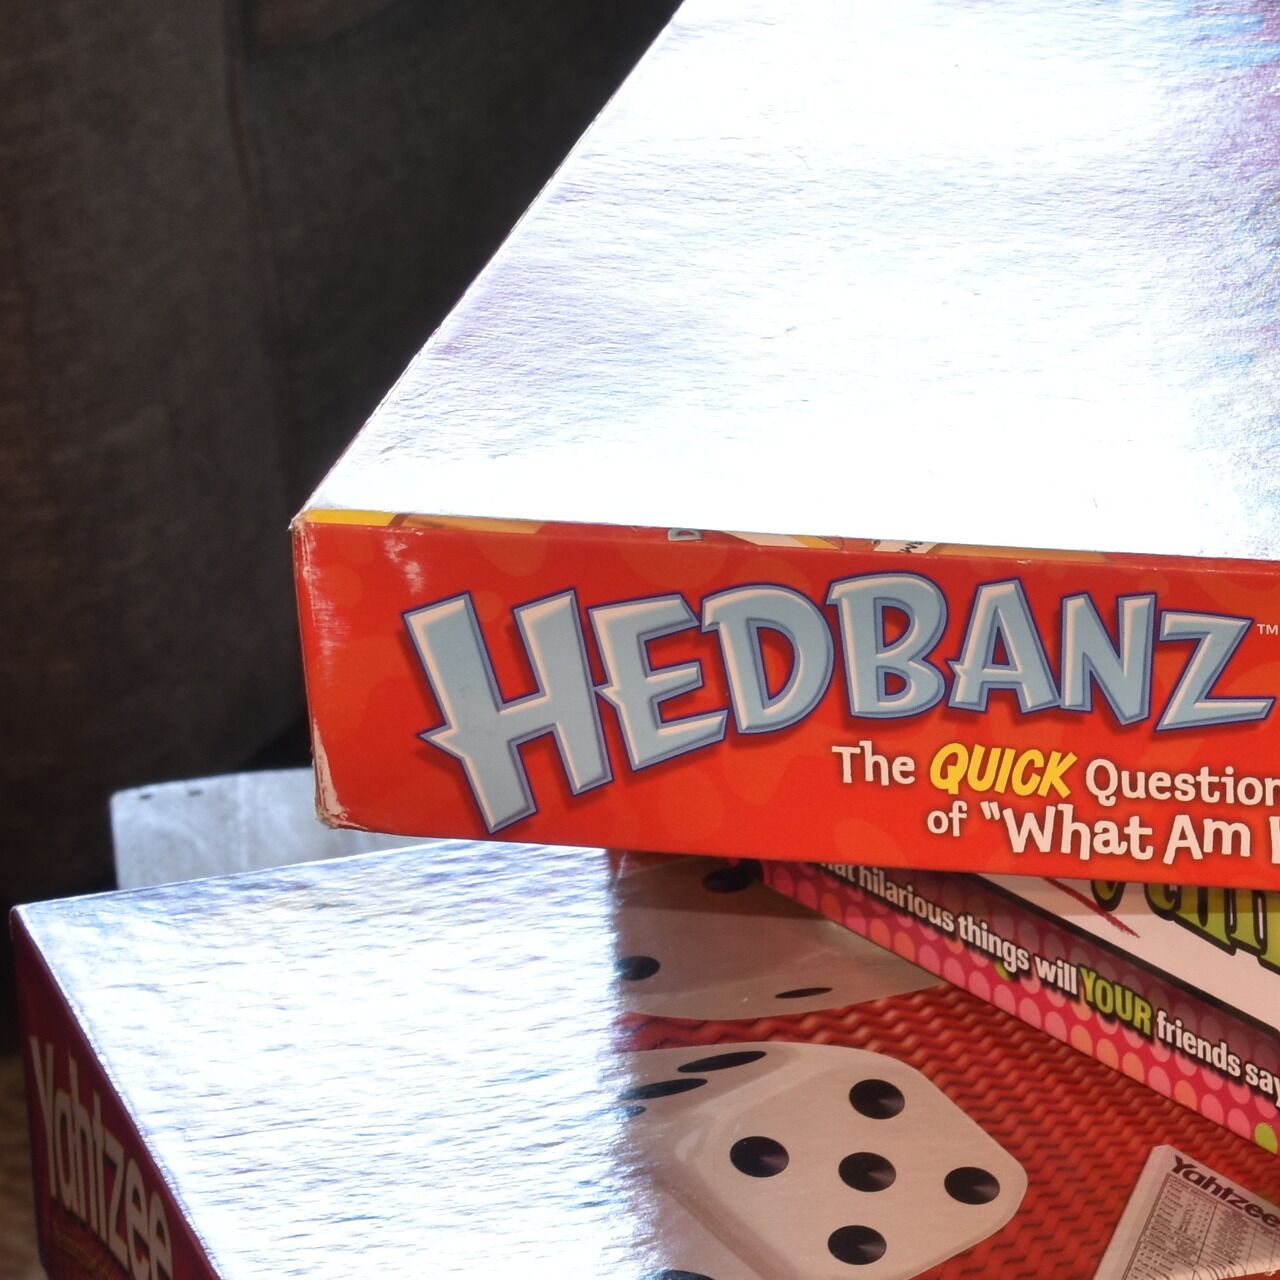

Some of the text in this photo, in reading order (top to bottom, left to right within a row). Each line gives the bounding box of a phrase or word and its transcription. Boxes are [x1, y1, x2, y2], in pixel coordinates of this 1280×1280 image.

[403, 571, 1277, 834] HEDBANZ
[831, 740, 916, 787] The
[928, 742, 1078, 800] QUICK
[926, 802, 968, 838] of
[1164, 812, 1252, 866] Am
[859, 866, 955, 932] hilarious
[957, 913, 1030, 974] things
[1035, 954, 1079, 996] will
[1079, 966, 1153, 1036] YOUR
[1156, 1010, 1241, 1076] friends
[1170, 1155, 1280, 1227] Yahtzee
